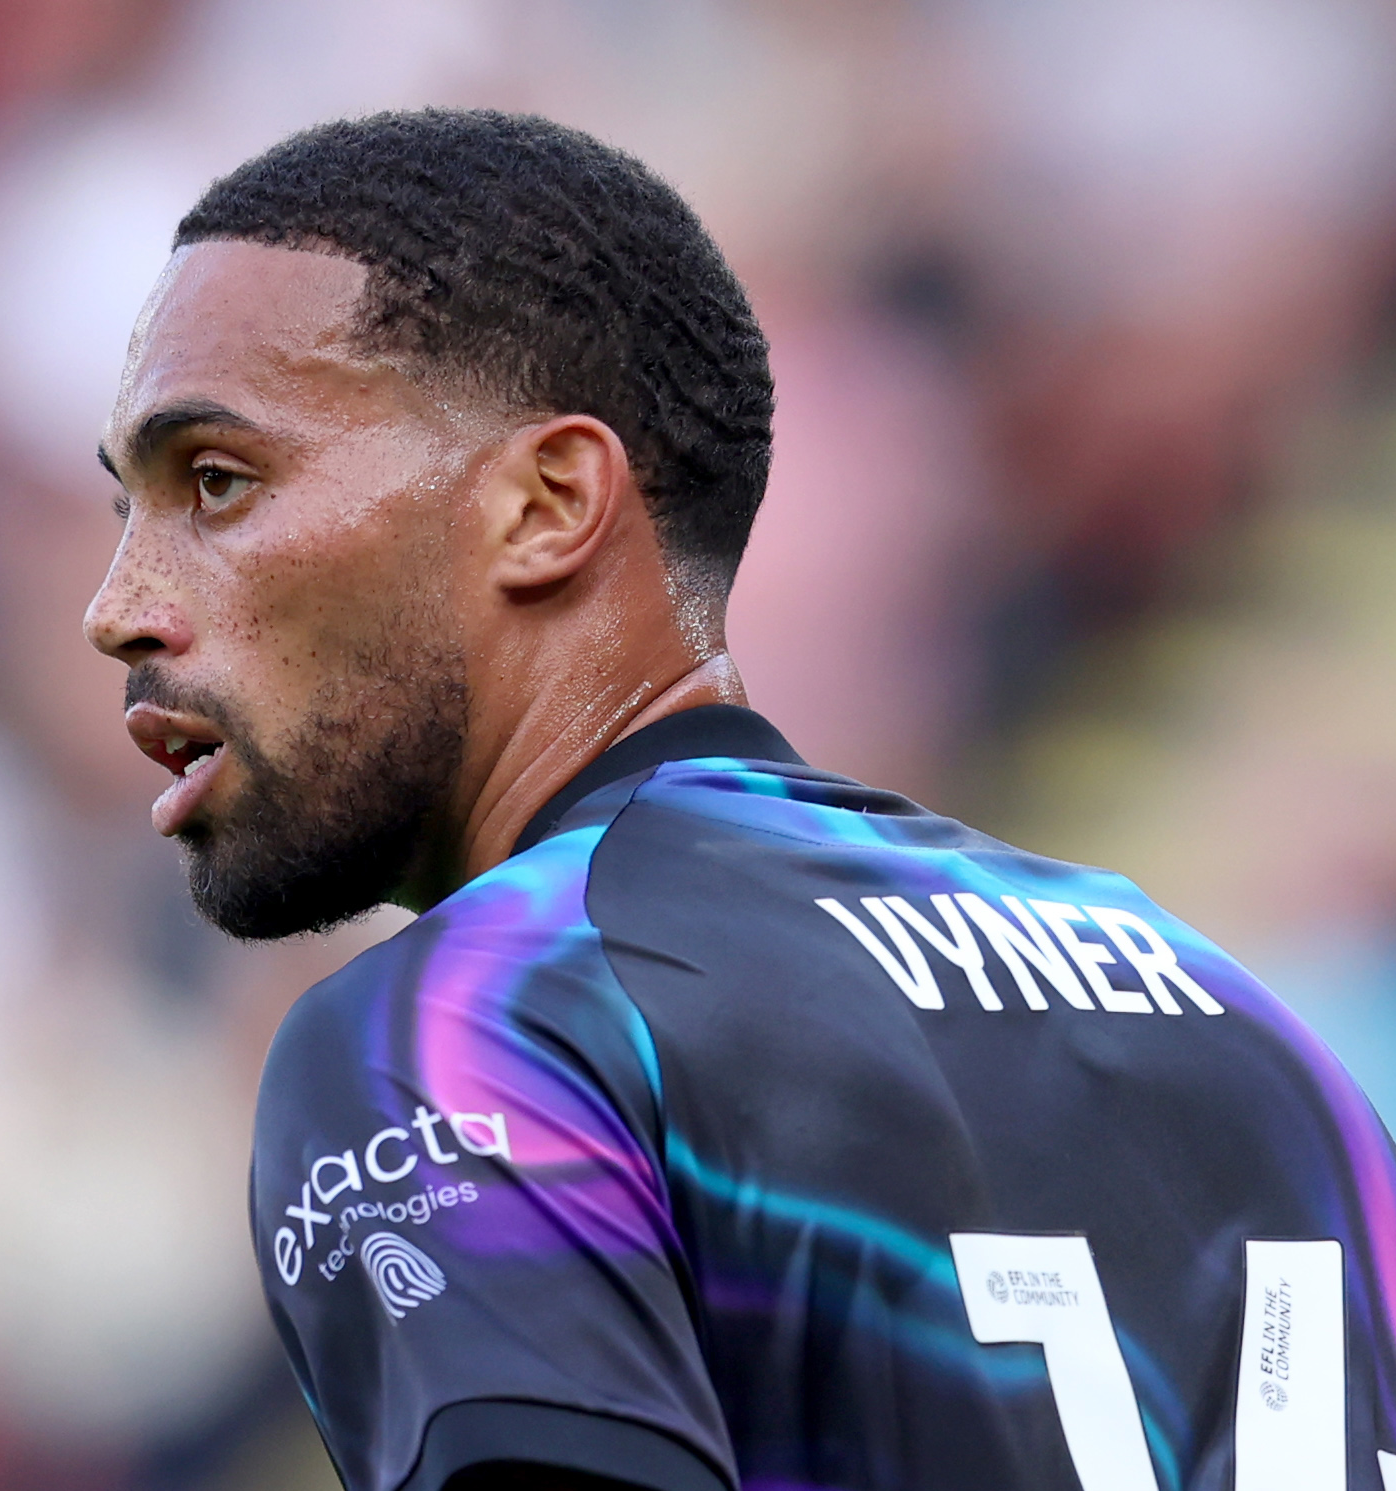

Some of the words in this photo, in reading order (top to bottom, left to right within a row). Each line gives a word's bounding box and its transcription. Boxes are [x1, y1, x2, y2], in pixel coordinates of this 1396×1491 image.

[813, 892, 1226, 1016] VYNER
[273, 1104, 513, 1287] exacta
[1007, 1270, 1027, 1287] EFL
[1028, 1271, 1041, 1288] IN
[1042, 1272, 1064, 1289] THE
[1013, 1289, 1079, 1307] COMMUNITY
[1264, 1286, 1277, 1318] THE
[1262, 1321, 1276, 1343] IN
[1275, 1277, 1292, 1381] COMMUNITY
[1260, 1346, 1274, 1375] EFL
